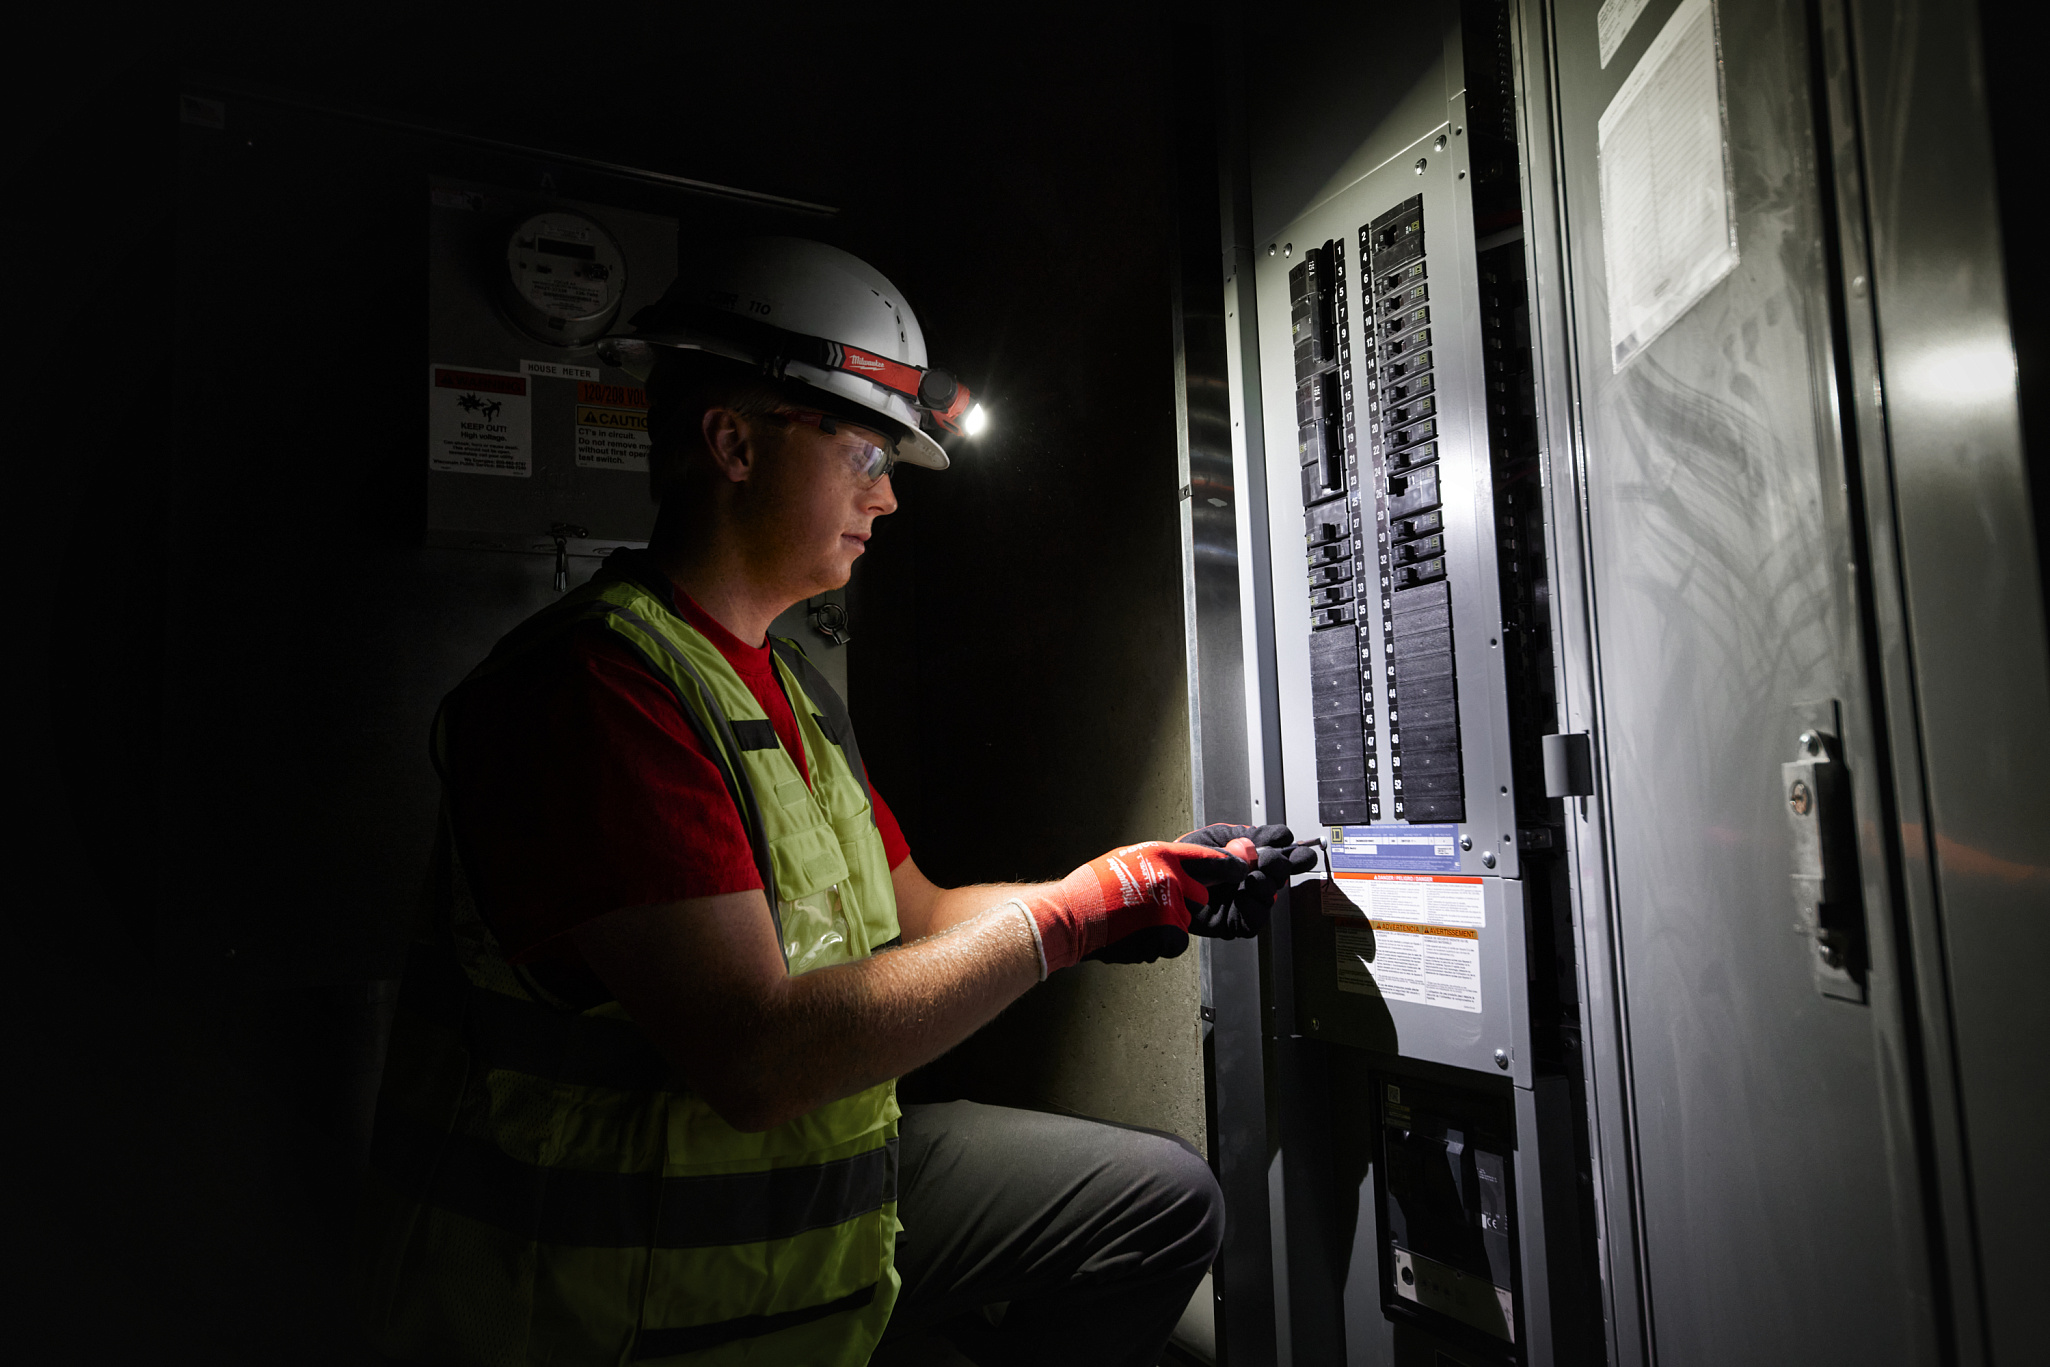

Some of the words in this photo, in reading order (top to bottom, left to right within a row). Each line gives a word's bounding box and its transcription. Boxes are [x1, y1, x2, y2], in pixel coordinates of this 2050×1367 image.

[749, 300, 771, 315] 110
[1365, 316, 1372, 327] 10
[1367, 337, 1374, 348] 12
[1342, 349, 1349, 359] 11
[850, 354, 885, 368] Milwaukee
[1368, 359, 1375, 369] 14
[528, 363, 557, 374] HOUSE
[562, 368, 591, 378] METER
[1343, 370, 1350, 381] 13
[455, 375, 521, 392] WARNING
[1369, 380, 1376, 391] 16
[584, 383, 625, 404] 120/208
[1345, 391, 1352, 401] 15
[1370, 402, 1377, 412] 18
[1346, 412, 1353, 422] 17
[461, 422, 485, 430] KEEP
[486, 424, 507, 433] OUT!
[1372, 424, 1379, 434] 20
[461, 431, 478, 440] High
[578, 428, 597, 436] CT's
[599, 429, 606, 437] in
[608, 431, 636, 440] circuit.
[1348, 433, 1355, 443] 19
[578, 437, 590, 445] Do
[608, 440, 637, 449] remove
[578, 446, 609, 455] without
[611, 448, 627, 457] first
[1373, 445, 1381, 456] 22
[578, 454, 594, 462] test
[596, 455, 625, 464] switch.
[1349, 455, 1356, 465] 21
[1350, 476, 1357, 487] 23
[1376, 489, 1383, 499] 26
[1353, 518, 1360, 529] 27
[1355, 540, 1362, 550] 29
[1380, 555, 1388, 565] 32
[1356, 562, 1363, 572] 31
[1382, 577, 1389, 587] 34
[1361, 627, 1368, 637] 37
[1385, 622, 1392, 632] 38
[1362, 648, 1369, 659] 39
[1386, 644, 1394, 654] 40
[1364, 671, 1371, 681] 41
[1388, 666, 1395, 676] 42
[1389, 689, 1397, 699] 44
[1366, 715, 1373, 725] 45
[1390, 712, 1398, 721] 46
[1368, 737, 1375, 747] 47
[1392, 734, 1399, 744] 48
[1393, 757, 1401, 767] 50
[1370, 782, 1377, 791] 51
[1395, 780, 1403, 790] 52
[1372, 804, 1379, 814] 53
[1396, 803, 1404, 813] 54
[1157, 869, 1166, 881] XL
[1382, 923, 1420, 934] ADVERTENCIA
[1429, 927, 1475, 938] AVERTISSEMENT
